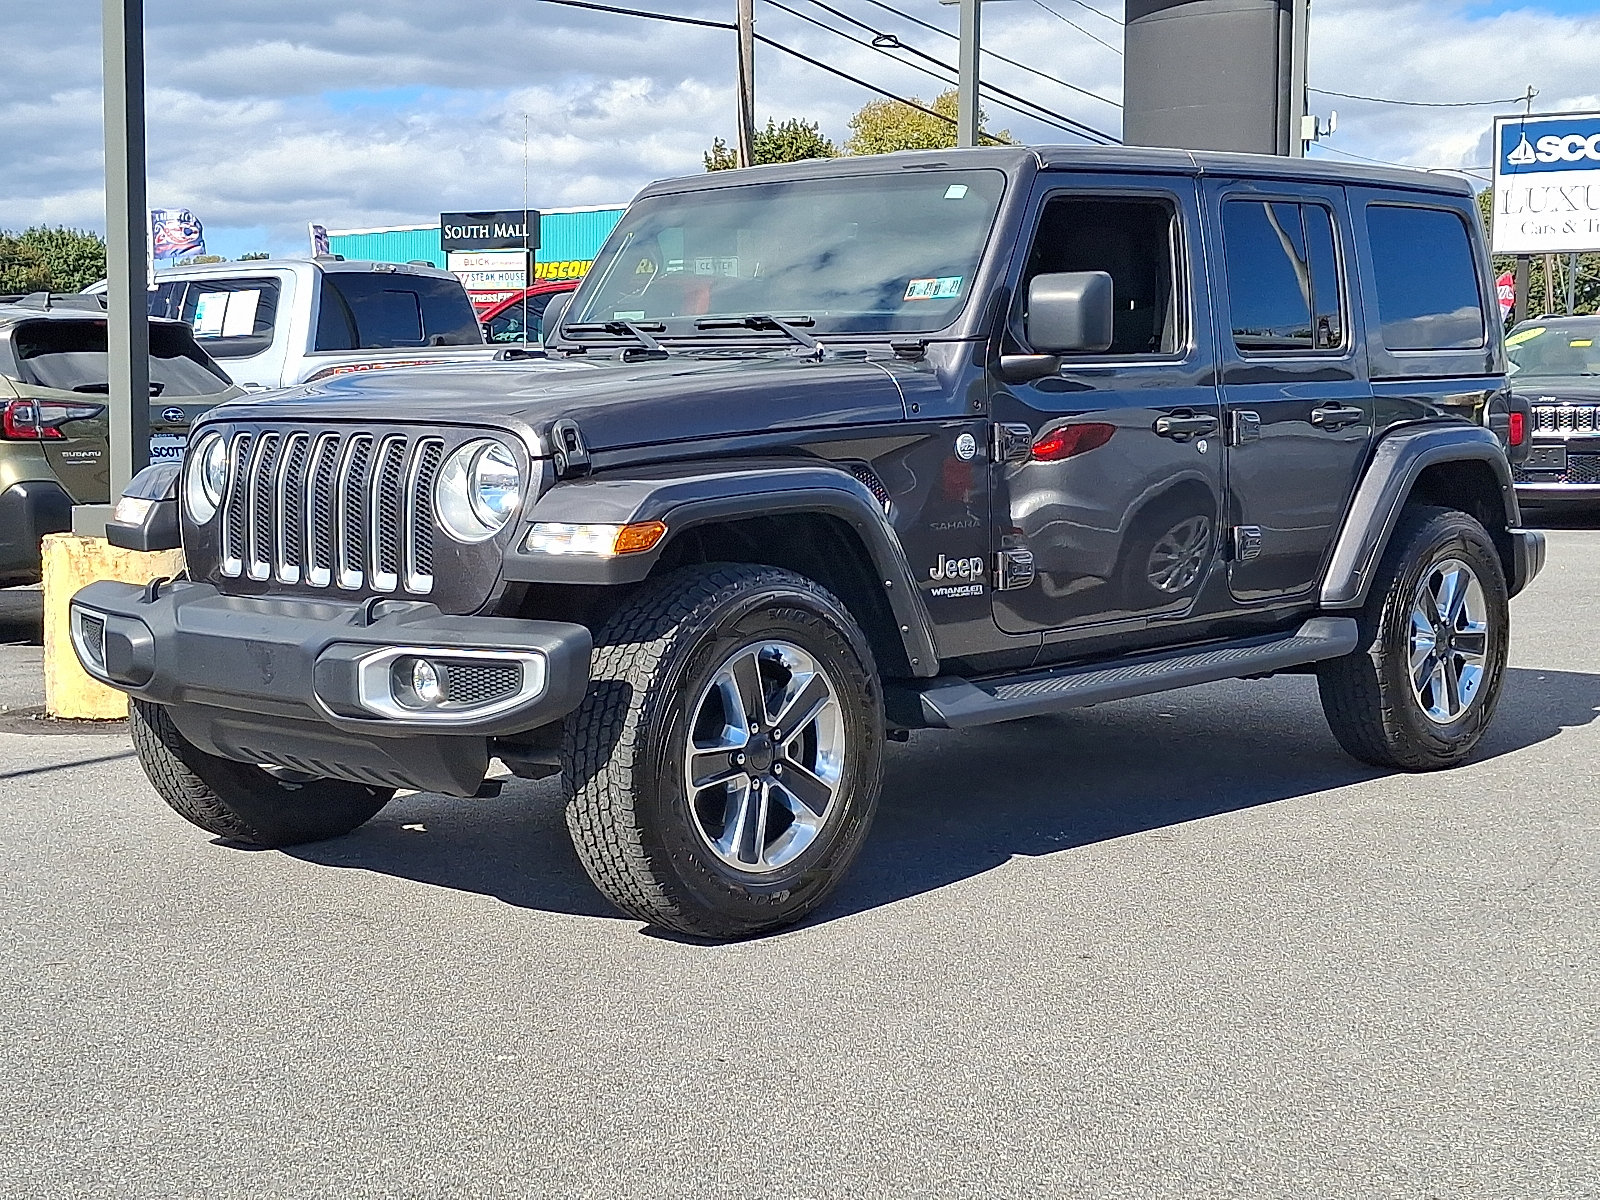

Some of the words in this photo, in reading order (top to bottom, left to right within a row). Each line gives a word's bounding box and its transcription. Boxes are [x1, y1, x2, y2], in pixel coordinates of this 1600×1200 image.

[1521, 219, 1556, 235] Cars
[1562, 219, 1577, 234] &
[463, 257, 491, 266] BLICK
[471, 272, 496, 282] STEAK
[498, 272, 525, 281] HOUSE
[930, 521, 980, 530] SAHARA
[929, 553, 984, 582] Jeep
[930, 584, 983, 597] WRANGLER
